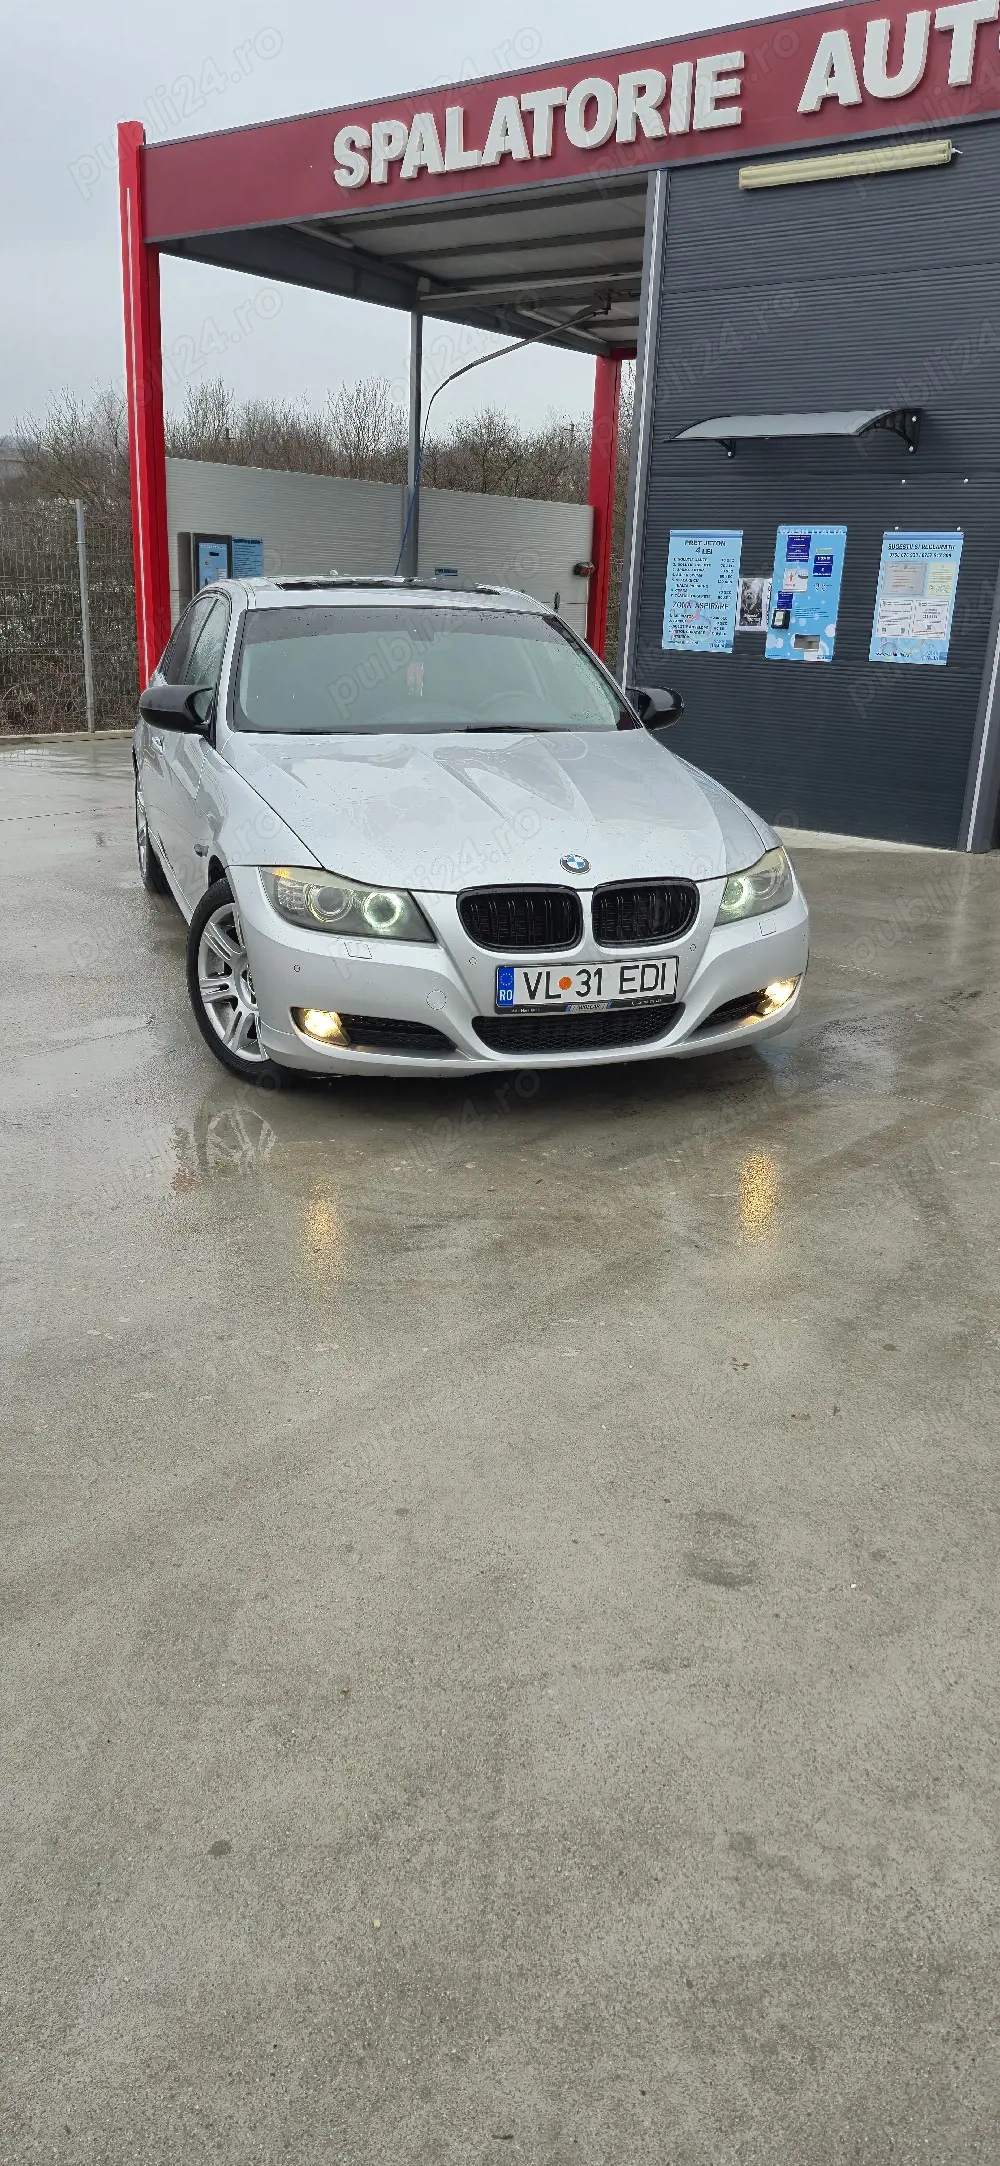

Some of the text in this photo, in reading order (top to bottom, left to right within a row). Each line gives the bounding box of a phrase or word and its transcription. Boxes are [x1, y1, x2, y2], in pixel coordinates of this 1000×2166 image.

[333, 0, 1000, 189] SPALATORIE AUT
[694, 602, 730, 610] ASPIRARE
[522, 962, 667, 1001] VL 31 EDI
[499, 989, 513, 1001] RO
